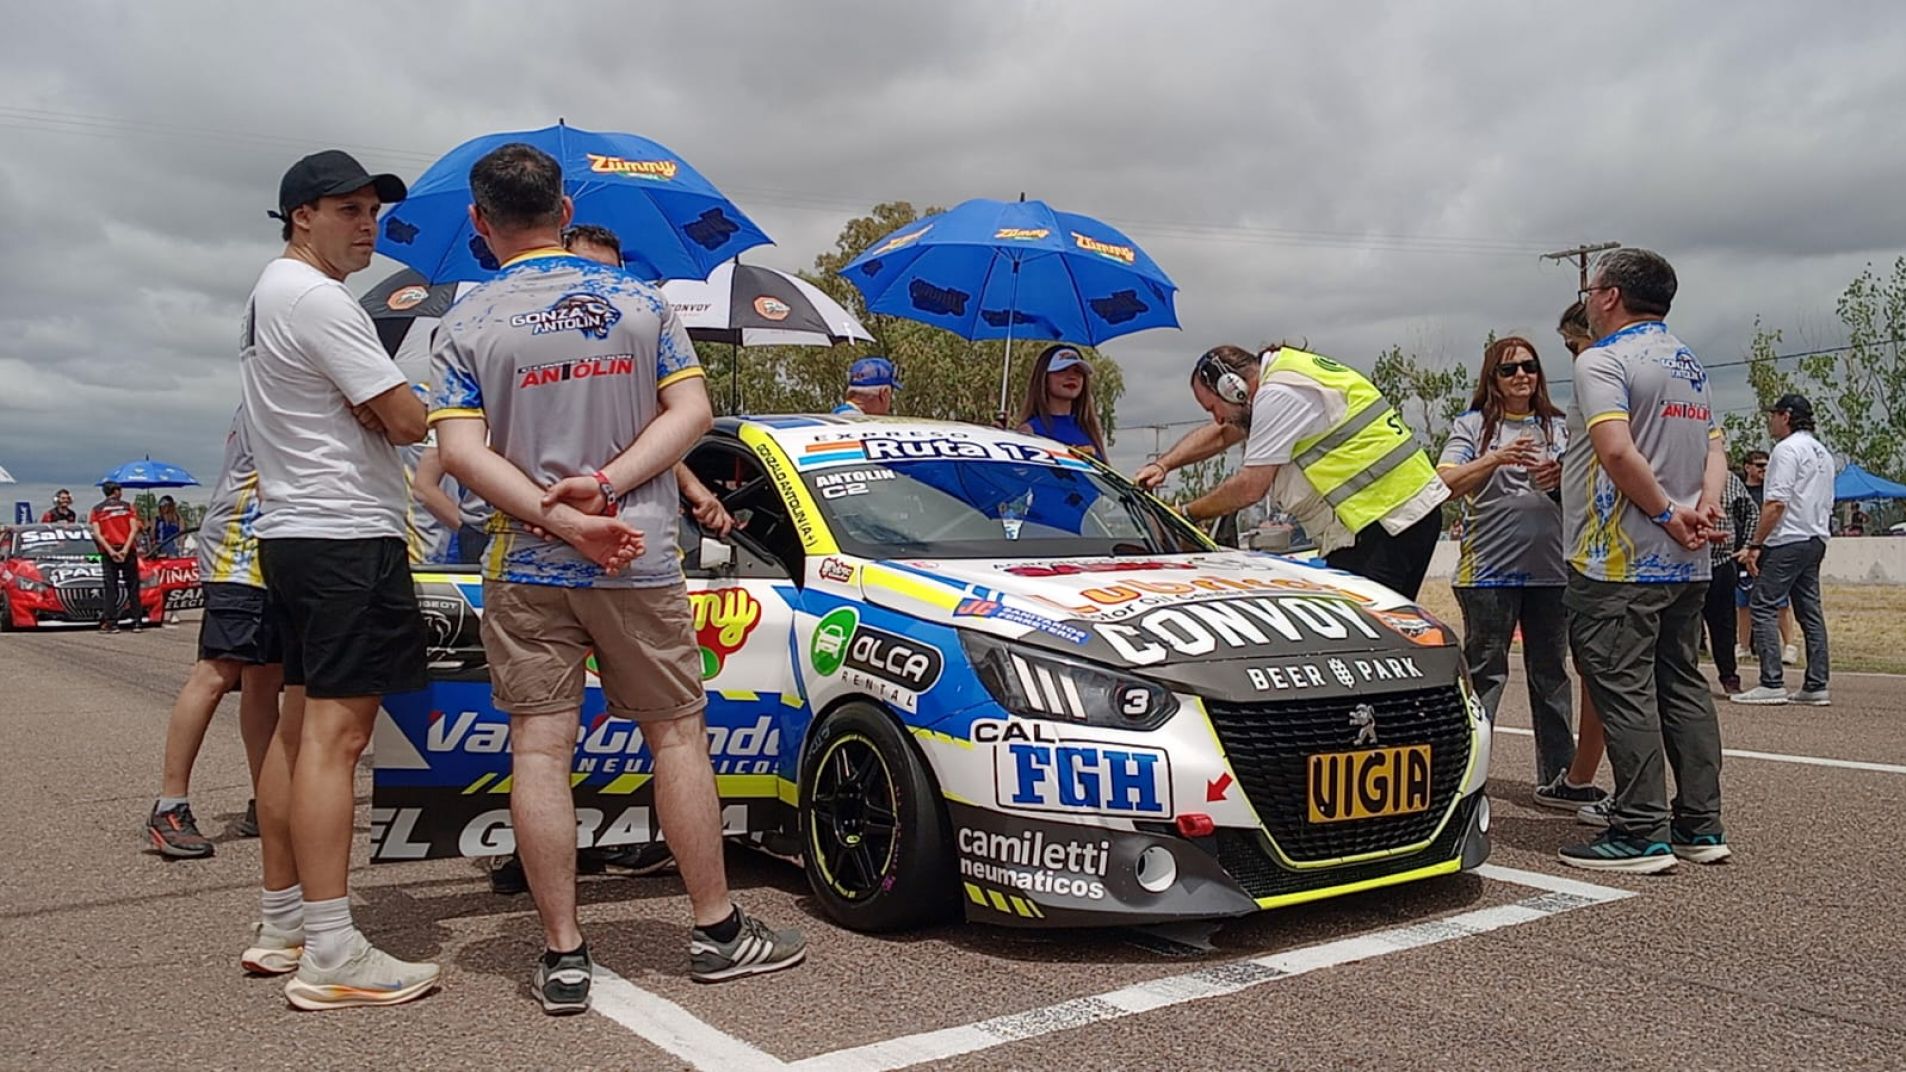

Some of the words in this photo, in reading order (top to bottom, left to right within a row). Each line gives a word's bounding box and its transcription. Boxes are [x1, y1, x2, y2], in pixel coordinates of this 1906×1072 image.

[511, 306, 584, 327] GONZA
[532, 315, 602, 335] ANTOLIN
[520, 359, 634, 389] ANTOLIN
[814, 431, 968, 441] EXPRESO
[863, 438, 988, 460] Ruta
[999, 442, 1058, 464] 12
[816, 469, 897, 488] ANTOLIN
[822, 483, 870, 499] C2
[417, 600, 458, 609] GEOT
[957, 600, 999, 616] JC
[1094, 597, 1381, 666] CONVOY
[852, 635, 930, 683] OLCA
[1247, 664, 1327, 691] BEER
[1358, 656, 1424, 682] PARK
[841, 671, 914, 707] RENTAL
[1123, 688, 1150, 716] 3
[1008, 744, 1164, 813] FGH
[958, 826, 1110, 877] camiletti
[960, 857, 1105, 900] neumaticos
